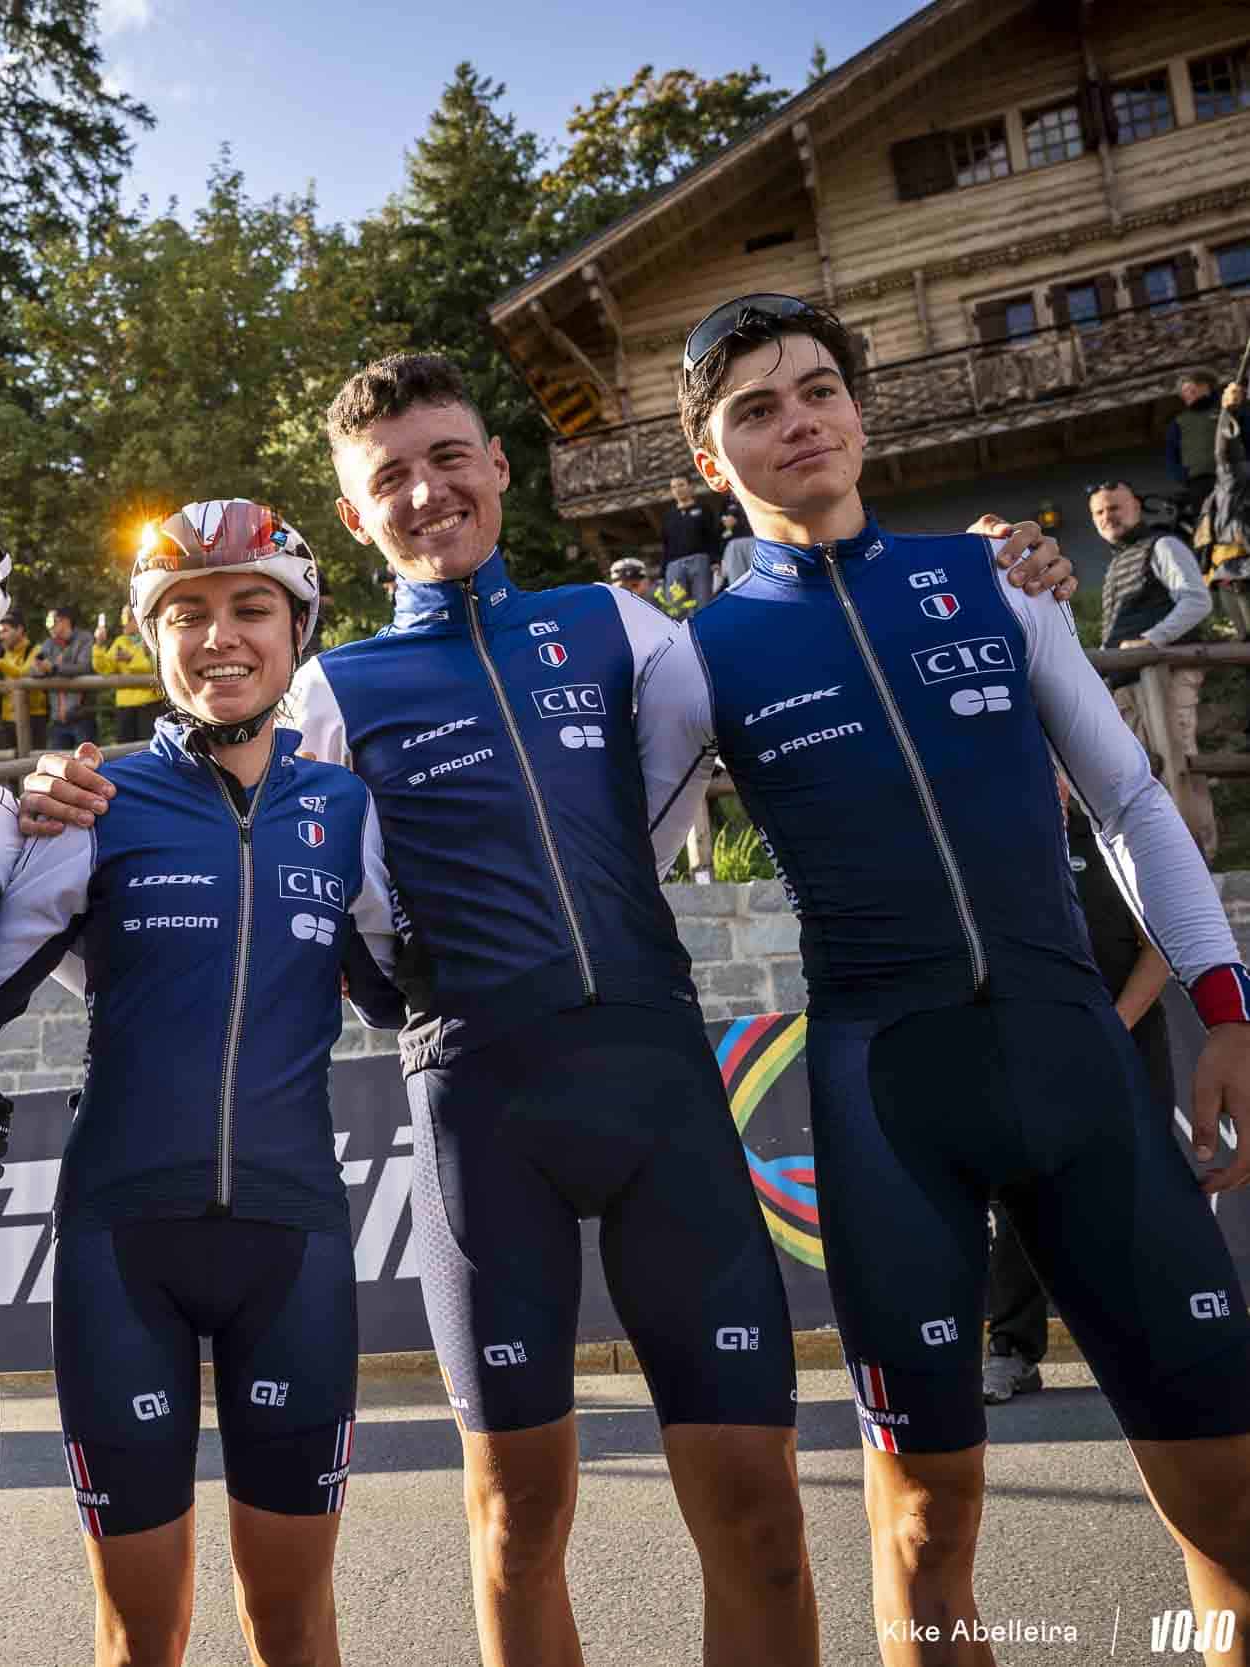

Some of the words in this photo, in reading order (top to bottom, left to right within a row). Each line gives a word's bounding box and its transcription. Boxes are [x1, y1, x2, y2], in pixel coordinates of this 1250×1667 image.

[927, 643, 1006, 674] CIC
[543, 690, 596, 711] CIC
[744, 685, 843, 726] LOOK
[402, 716, 479, 749] LOOK
[780, 721, 863, 755] FACOM
[430, 748, 494, 777] FACOM
[128, 875, 220, 888] LOOK
[287, 872, 342, 902] CIC
[146, 916, 219, 929] FACOM
